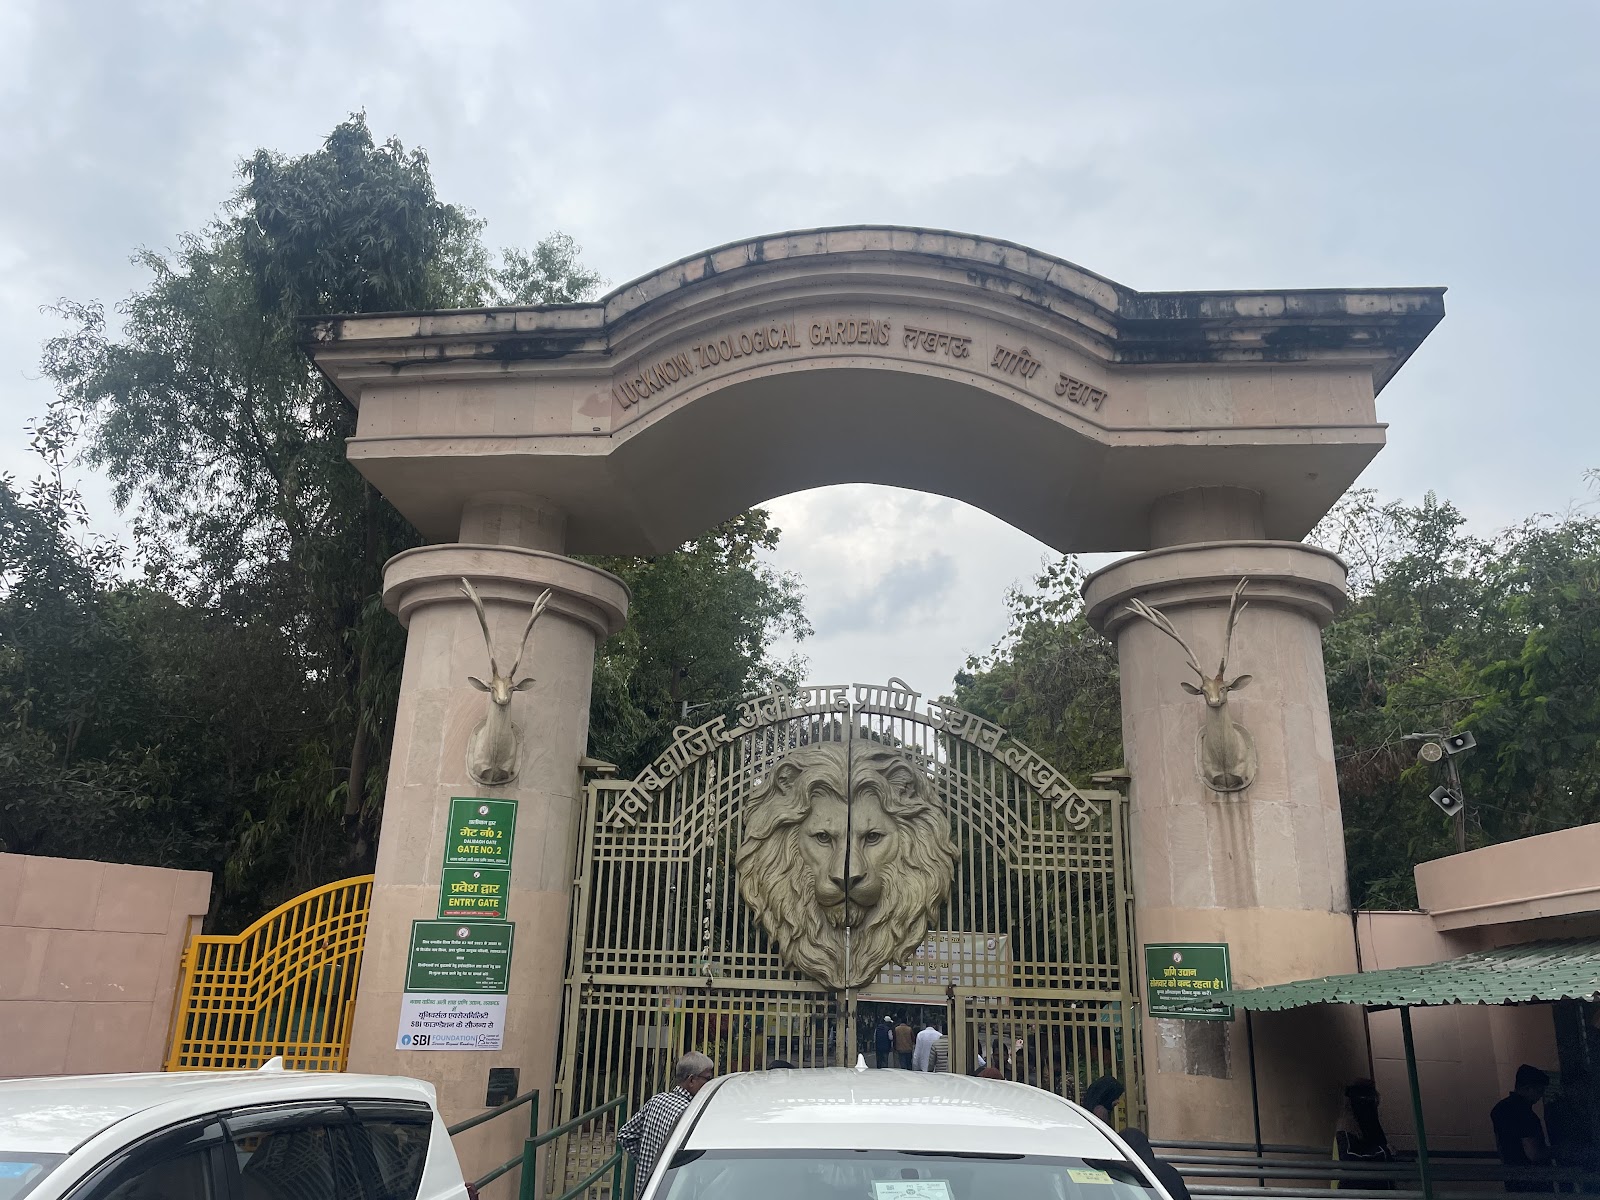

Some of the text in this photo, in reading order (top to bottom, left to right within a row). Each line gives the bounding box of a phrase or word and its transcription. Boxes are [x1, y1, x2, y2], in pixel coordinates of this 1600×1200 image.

[612, 319, 891, 409] LUCKNOW ZOOLOGICAL GARDENS
[903, 325, 1108, 411] लखनऊ प्राणि उद्यान
[605, 677, 1102, 831] नवाब वाजिद अली शाह प्राणि उद्यान लखनऊ
[460, 827, 478, 837] गेट
[457, 845, 479, 854] GATE
[480, 846, 495, 855] NO.
[451, 881, 500, 894] प्रवेश द्वार
[448, 898, 499, 907] ENTRY GATE
[1163, 966, 1197, 977] प्राणि उद्यान
[1168, 977, 1176, 988] को
[1192, 980, 1211, 989] रहता
[412, 1035, 430, 1046] SBI
